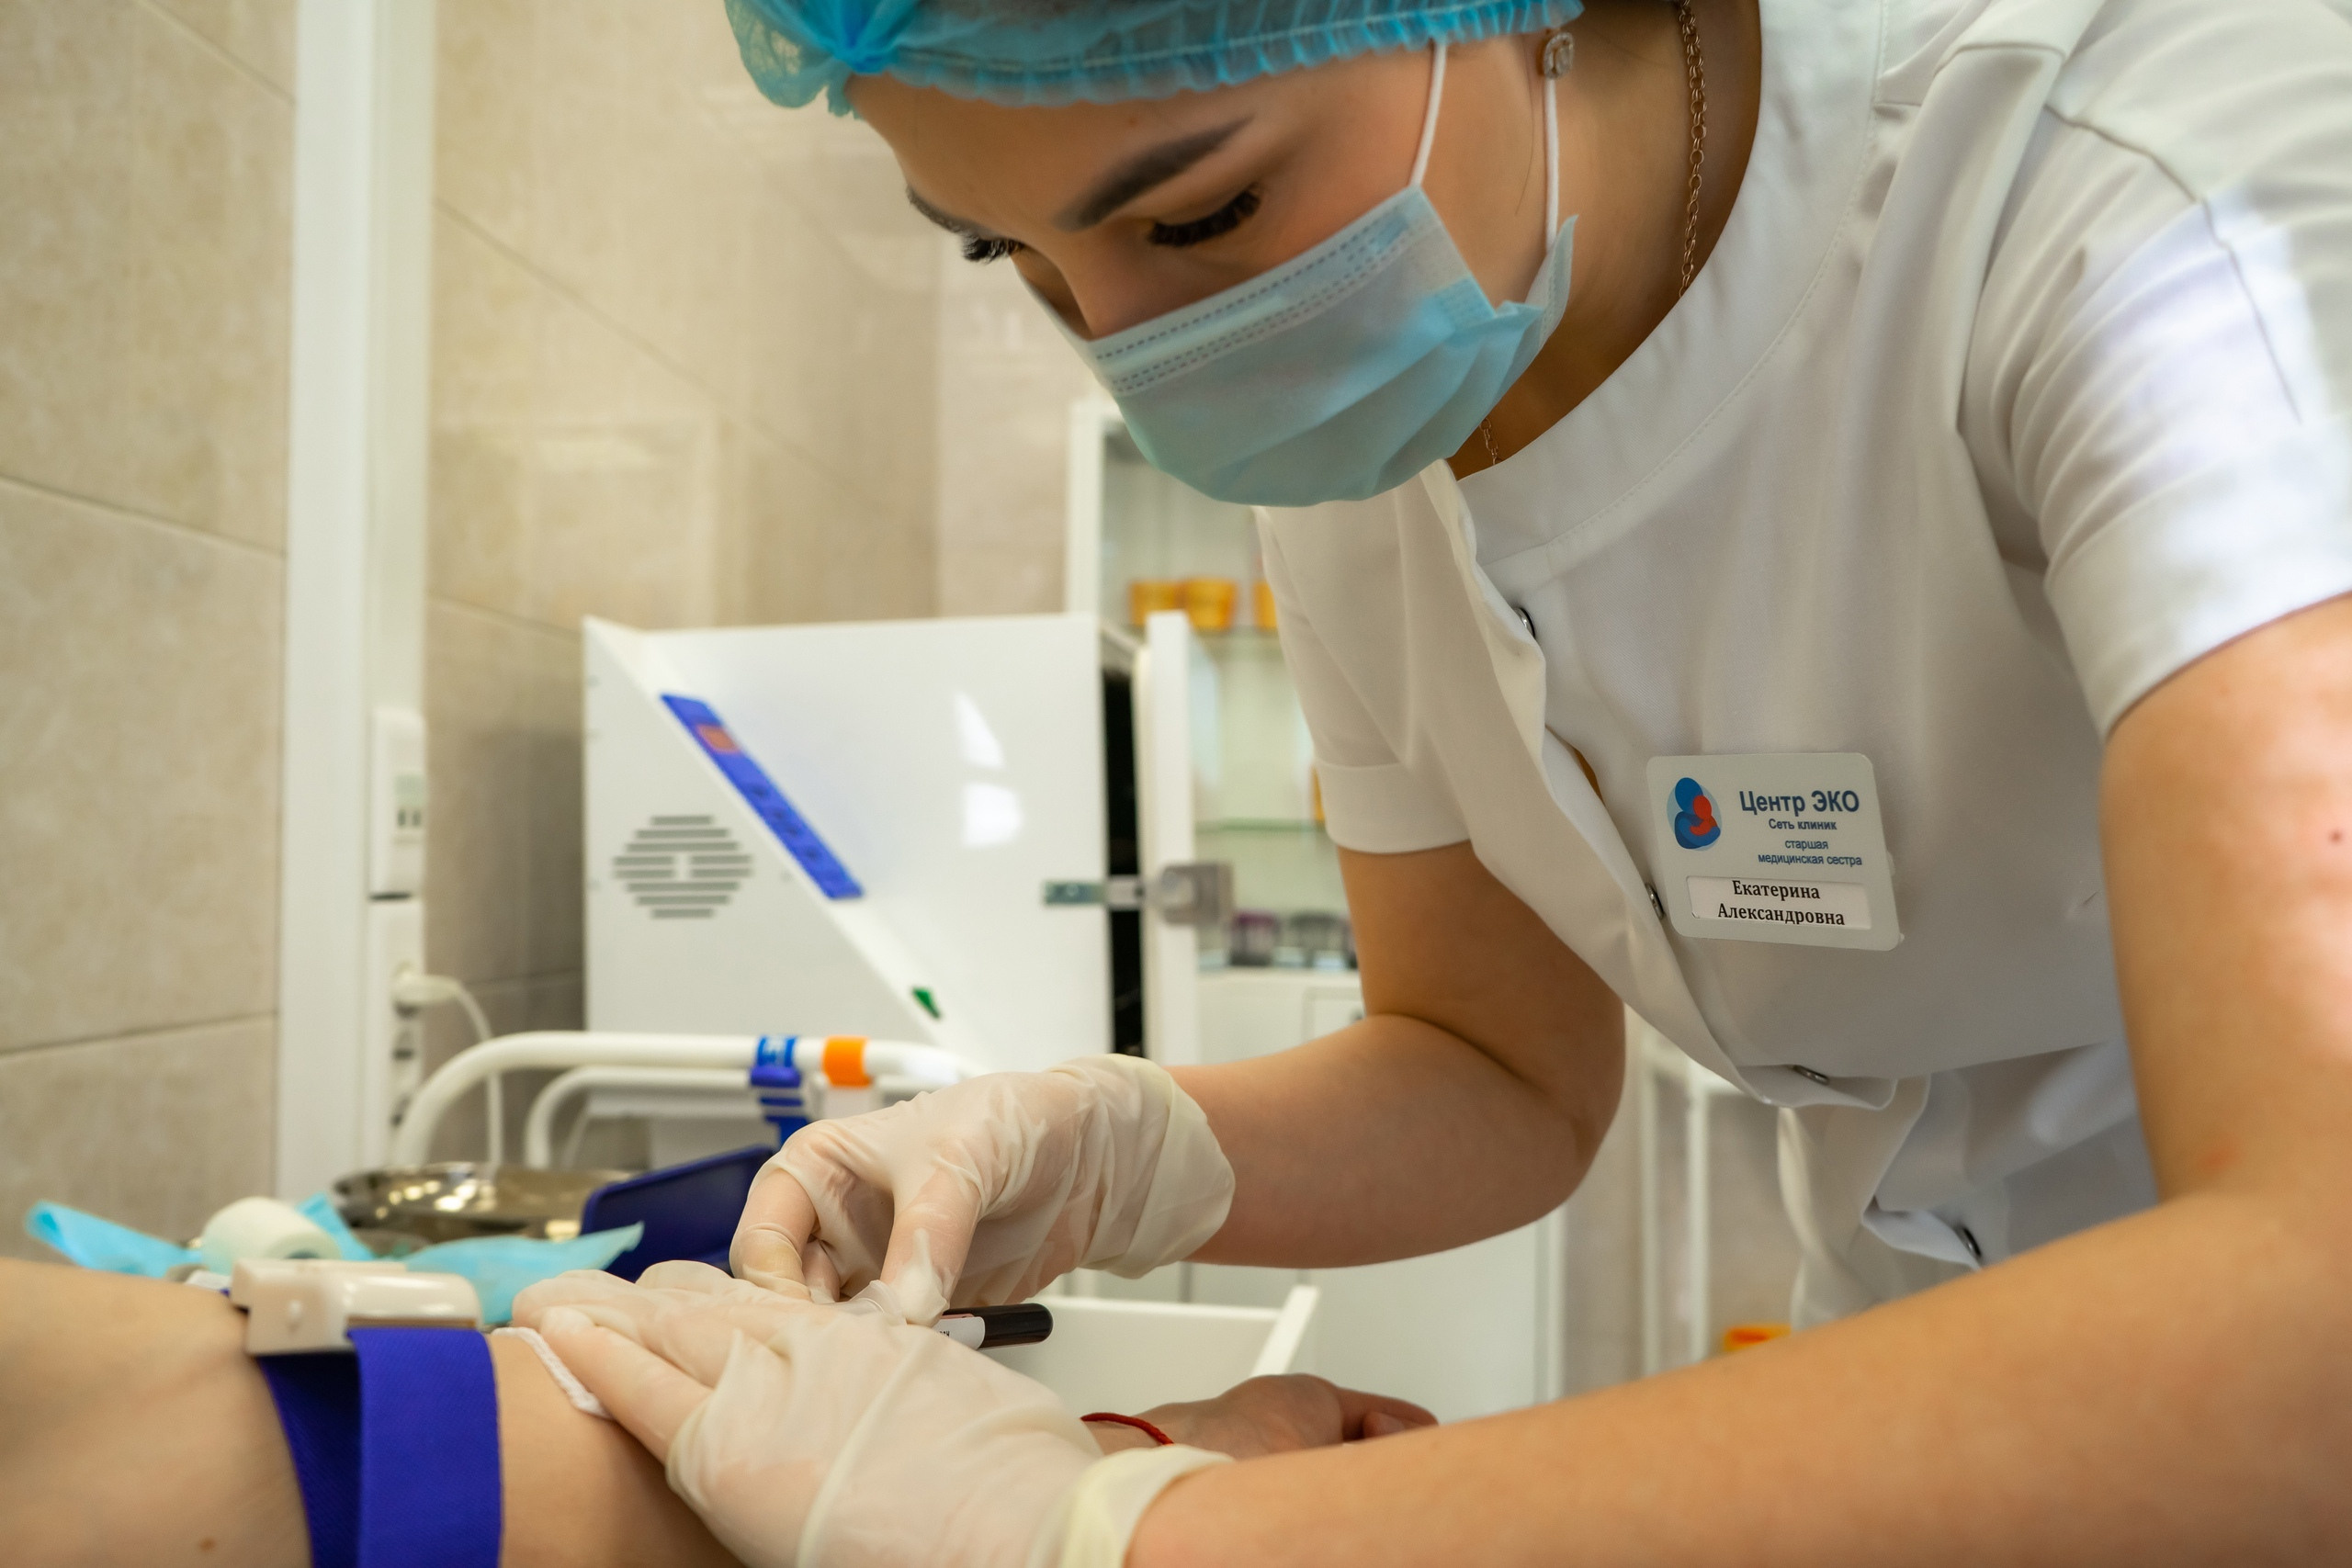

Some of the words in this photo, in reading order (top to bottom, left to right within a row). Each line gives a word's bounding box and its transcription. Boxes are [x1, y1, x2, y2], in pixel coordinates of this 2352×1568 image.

[1739, 790, 1806, 817] Центр
[1811, 790, 1860, 813] ЭКО
[1768, 818, 1795, 830] Сеть
[1797, 819, 1838, 830] клиник
[1784, 839, 1829, 852] старшая
[1758, 853, 1824, 865] медицинская
[1826, 854, 1862, 867] сестра
[1732, 880, 1821, 901] Екатерина
[1717, 903, 1845, 926] Александровна
